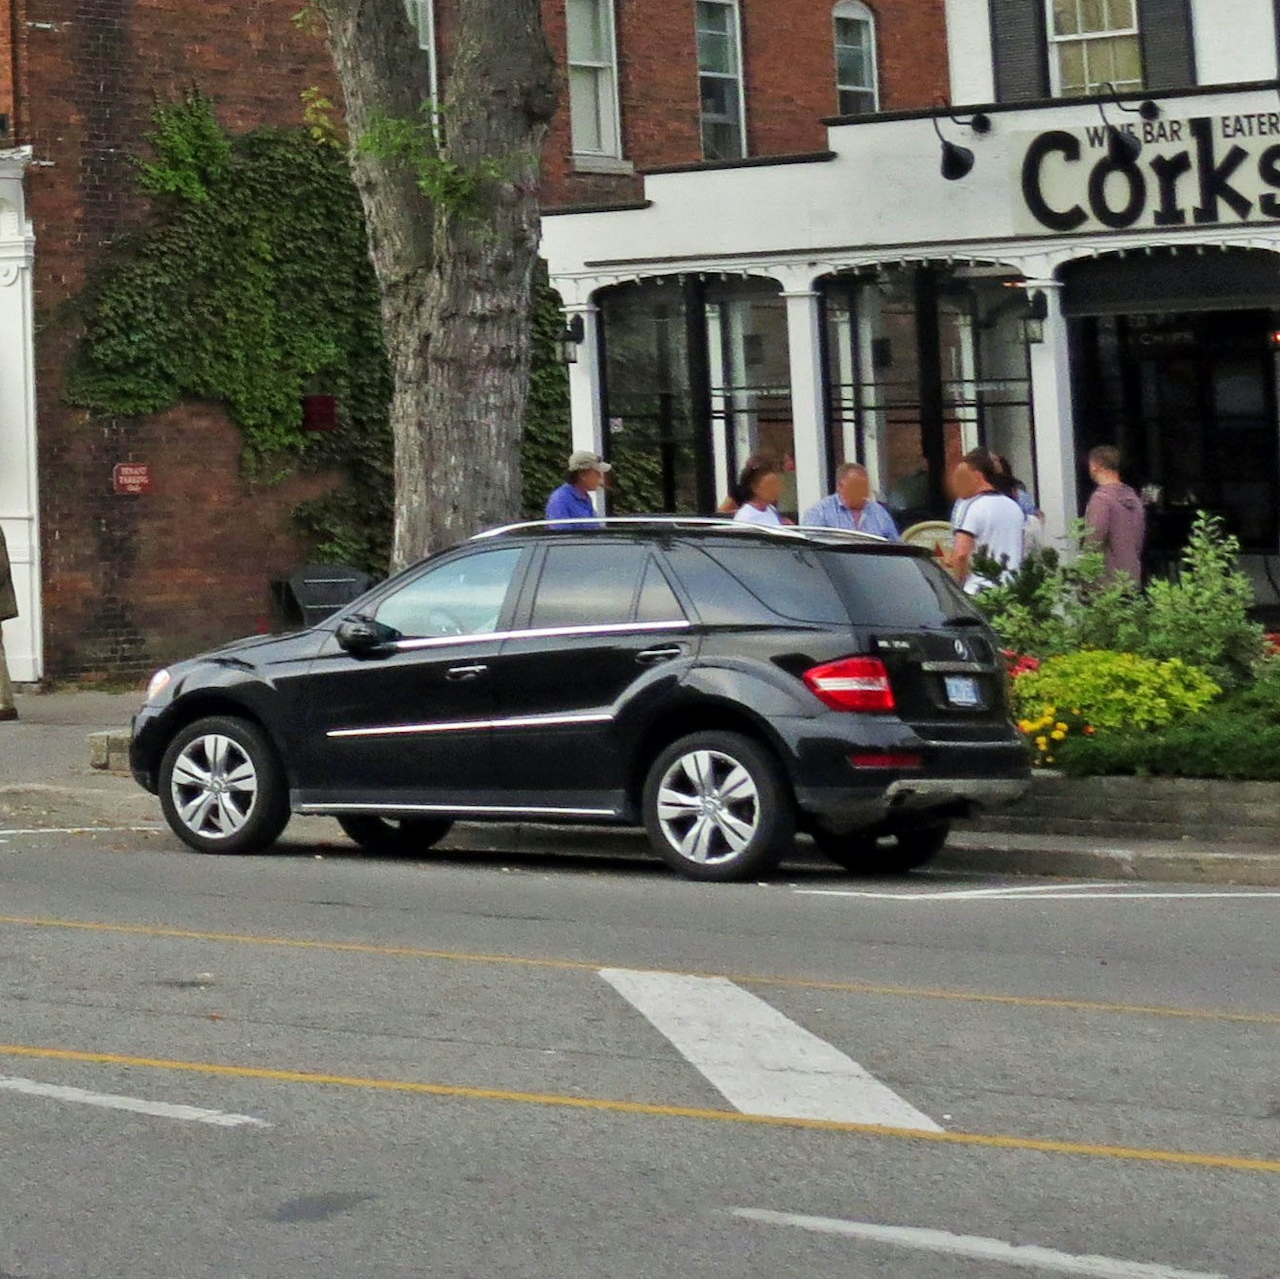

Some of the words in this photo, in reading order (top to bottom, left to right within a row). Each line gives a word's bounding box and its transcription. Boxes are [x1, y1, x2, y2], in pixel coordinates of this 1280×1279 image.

[1085, 123, 1135, 147] WE
[1142, 120, 1182, 143] BAR
[1221, 113, 1280, 138] EATER
